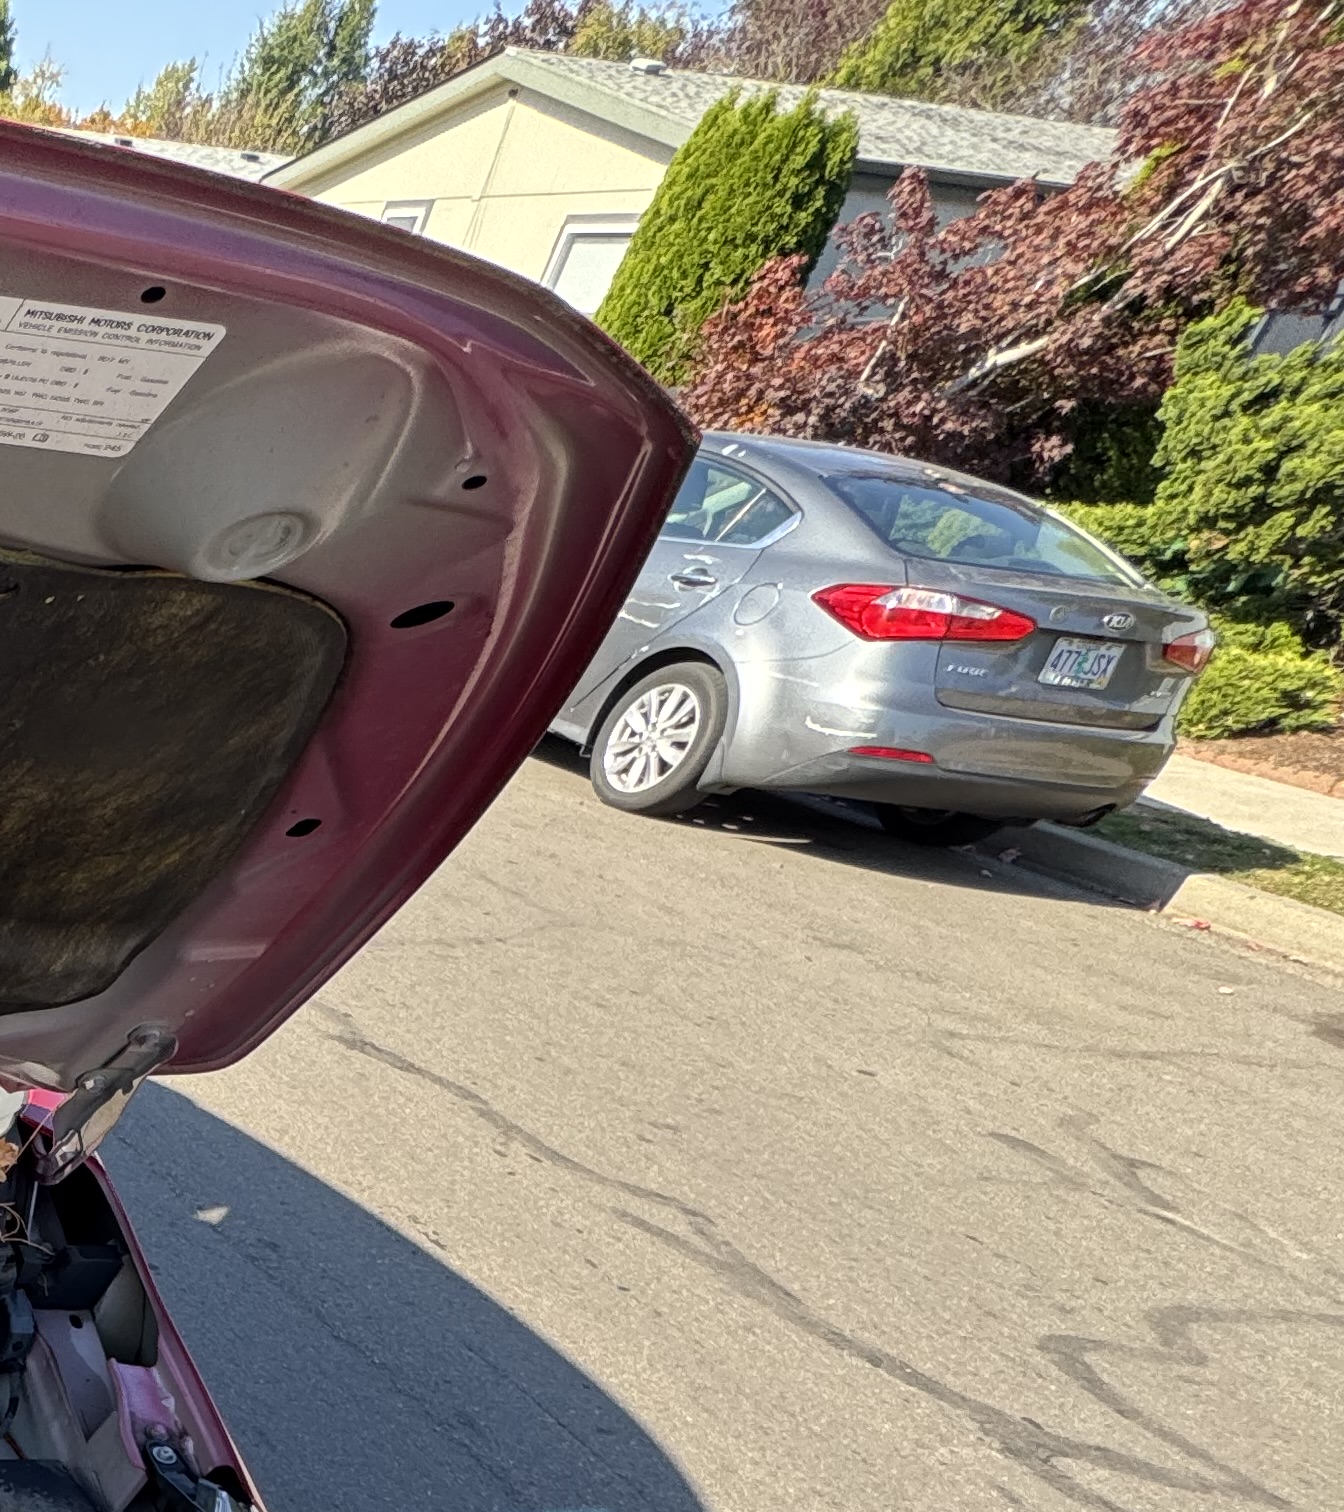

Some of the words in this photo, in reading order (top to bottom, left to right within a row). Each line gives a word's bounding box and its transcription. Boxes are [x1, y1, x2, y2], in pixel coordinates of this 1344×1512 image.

[19, 322, 54, 332] VEHICLE
[102, 333, 140, 343] CONTROL
[25, 310, 85, 324] MITSUBISHI
[89, 318, 132, 330] MOTORS
[137, 324, 214, 340] CORPORATION
[1050, 649, 1082, 672] 477
[1083, 653, 1116, 677] JSX
